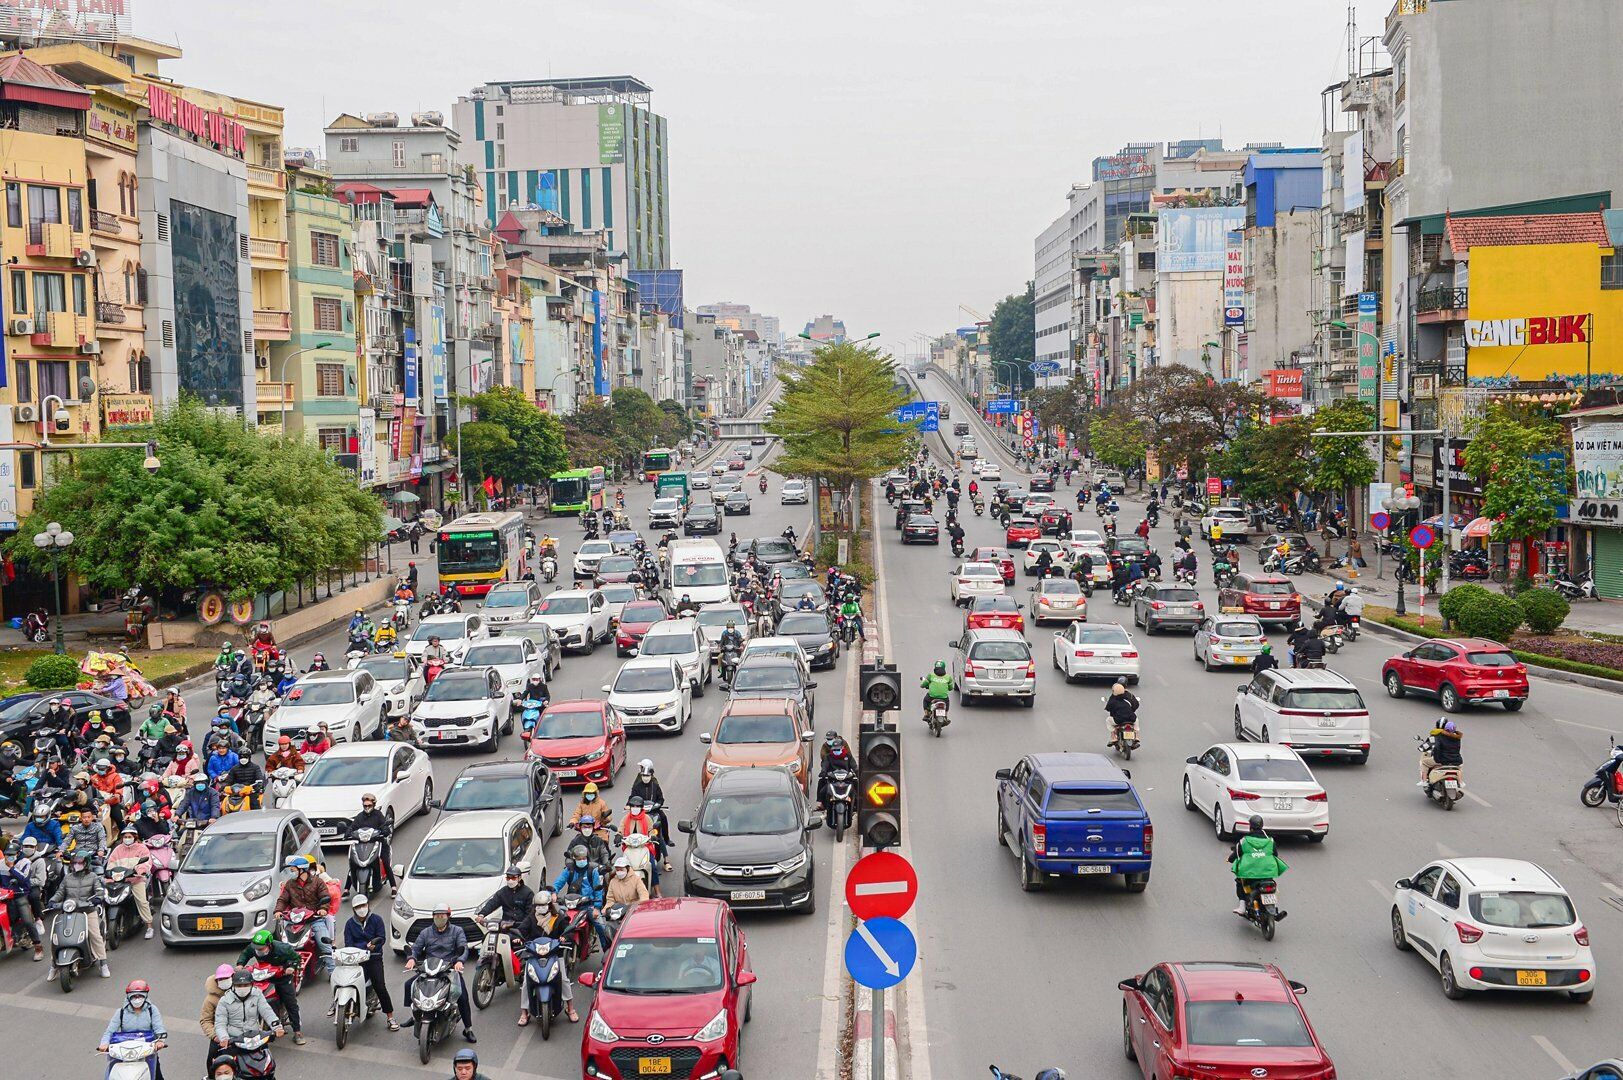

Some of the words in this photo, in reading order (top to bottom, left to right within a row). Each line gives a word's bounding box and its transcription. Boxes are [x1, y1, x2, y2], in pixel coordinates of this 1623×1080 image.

[175, 96, 206, 140] KHOA
[1228, 250, 1242, 260] MÁY
[1228, 264, 1243, 274] BƠM
[1226, 275, 1244, 287] NƯỚC
[1464, 318, 1526, 347] GANG
[1529, 314, 1588, 345] BUK
[1034, 362, 1055, 372] Ford
[1576, 437, 1585, 450] ĐỒ
[1586, 441, 1595, 450] DA
[1597, 439, 1612, 452] VIỆT
[1613, 441, 1623, 450] NA
[1578, 500, 1598, 518] ÁO
[1600, 503, 1619, 518] DA
[642, 1065, 668, 1073] 004.42
